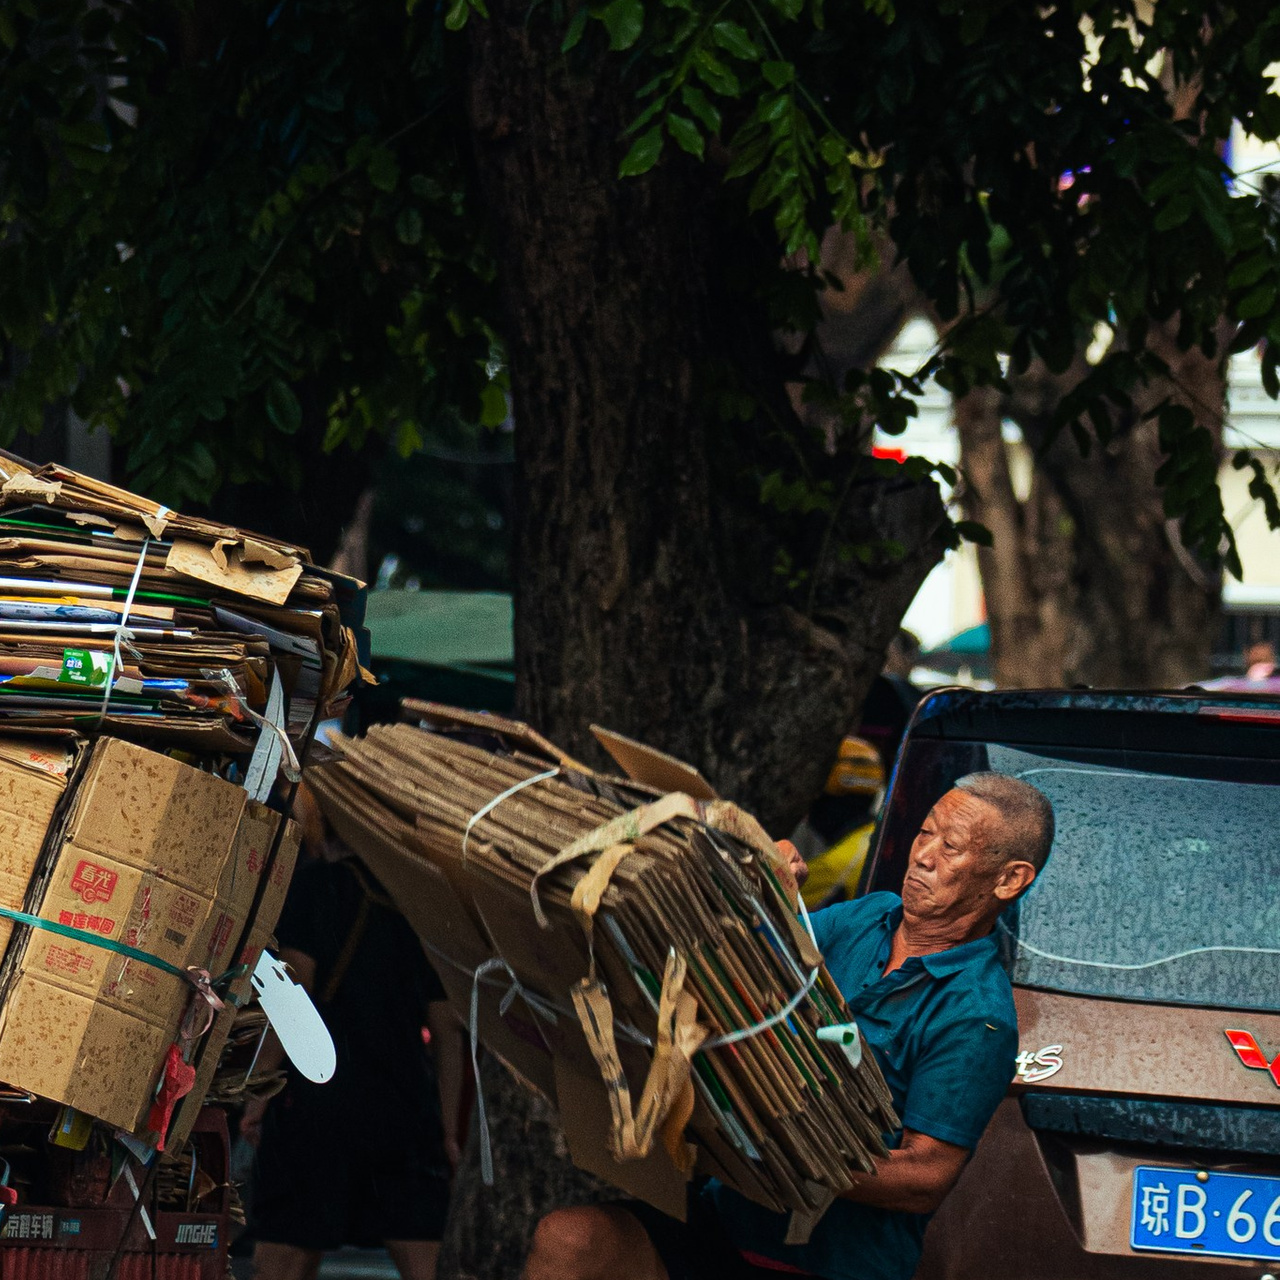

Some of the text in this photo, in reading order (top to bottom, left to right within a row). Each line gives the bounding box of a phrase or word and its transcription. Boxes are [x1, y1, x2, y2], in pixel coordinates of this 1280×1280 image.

[80, 864, 113, 889] 春光
[6, 1214, 55, 1239] 京鹤车辆
[174, 1224, 216, 1244] JINGHE
